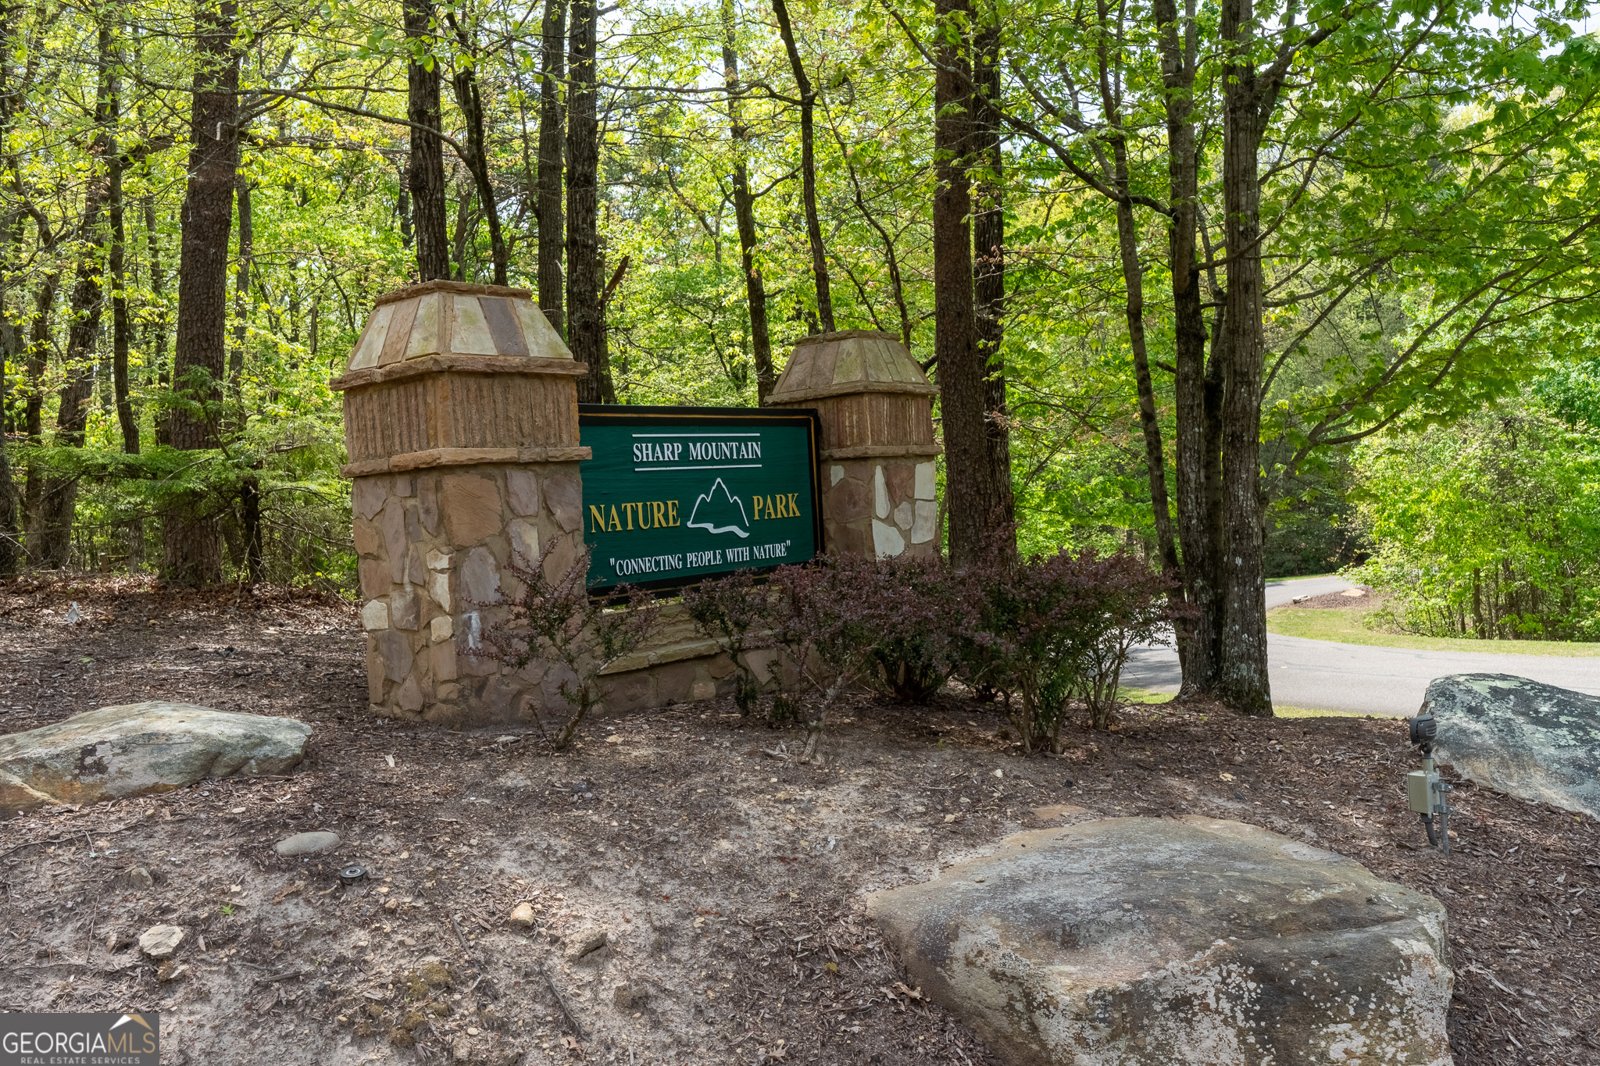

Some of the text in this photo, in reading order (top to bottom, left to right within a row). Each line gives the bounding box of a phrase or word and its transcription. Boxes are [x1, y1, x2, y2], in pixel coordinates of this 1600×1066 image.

[633, 441, 761, 463] SHARP MOUNTAIN
[589, 493, 801, 533] NATURE PARK
[610, 540, 791, 576] "CONNECTING PEOPLE WITH NATURE"
